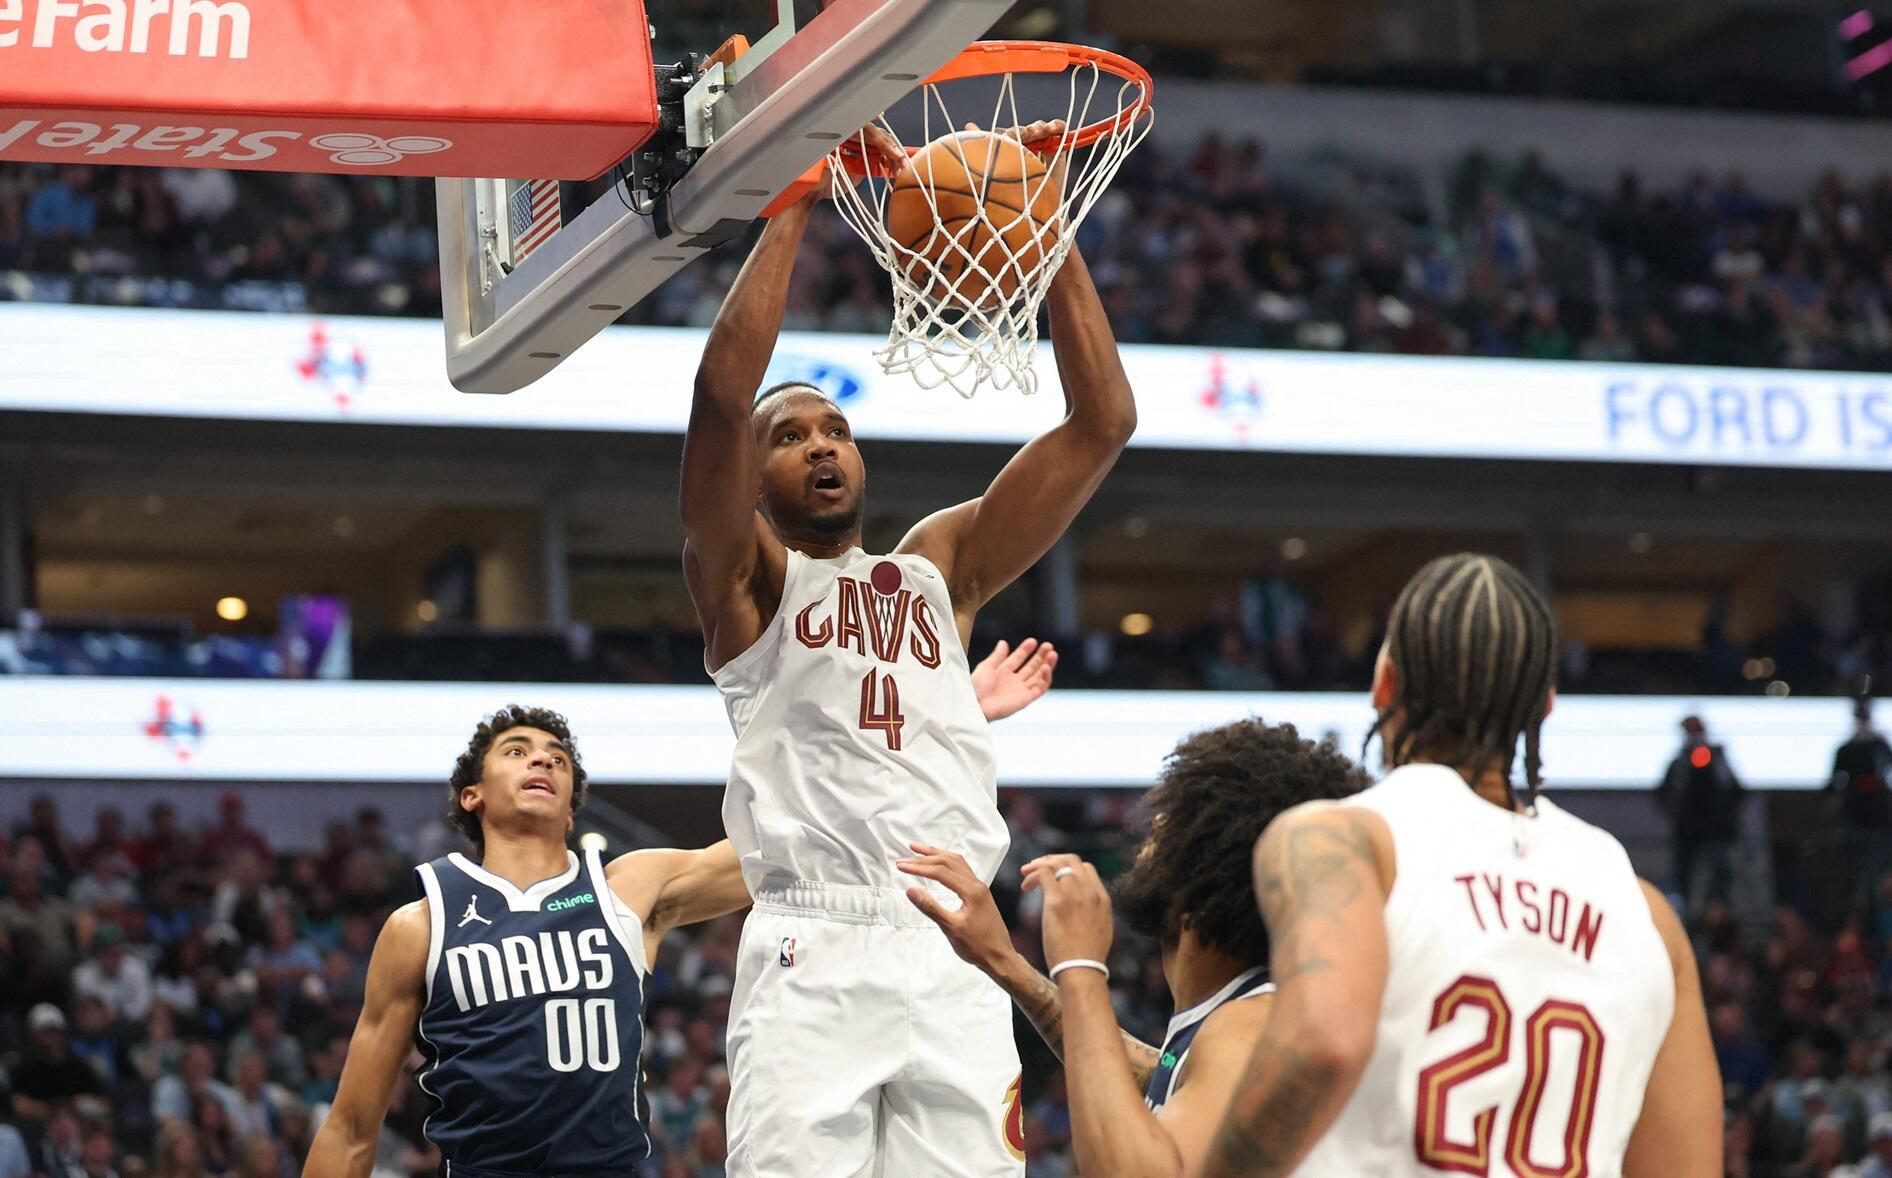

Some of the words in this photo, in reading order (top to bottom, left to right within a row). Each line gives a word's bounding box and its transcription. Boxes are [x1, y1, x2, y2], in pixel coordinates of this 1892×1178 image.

[1605, 383, 1809, 446] FORD
[1838, 391, 1892, 450] IS
[795, 576, 942, 670] CAVS
[859, 666, 904, 751] 4
[547, 893, 595, 911] chime
[1454, 874, 1604, 962] TYSON
[445, 928, 614, 1013] MAVS
[545, 998, 621, 1072] 00
[1415, 974, 1605, 1178] 20
